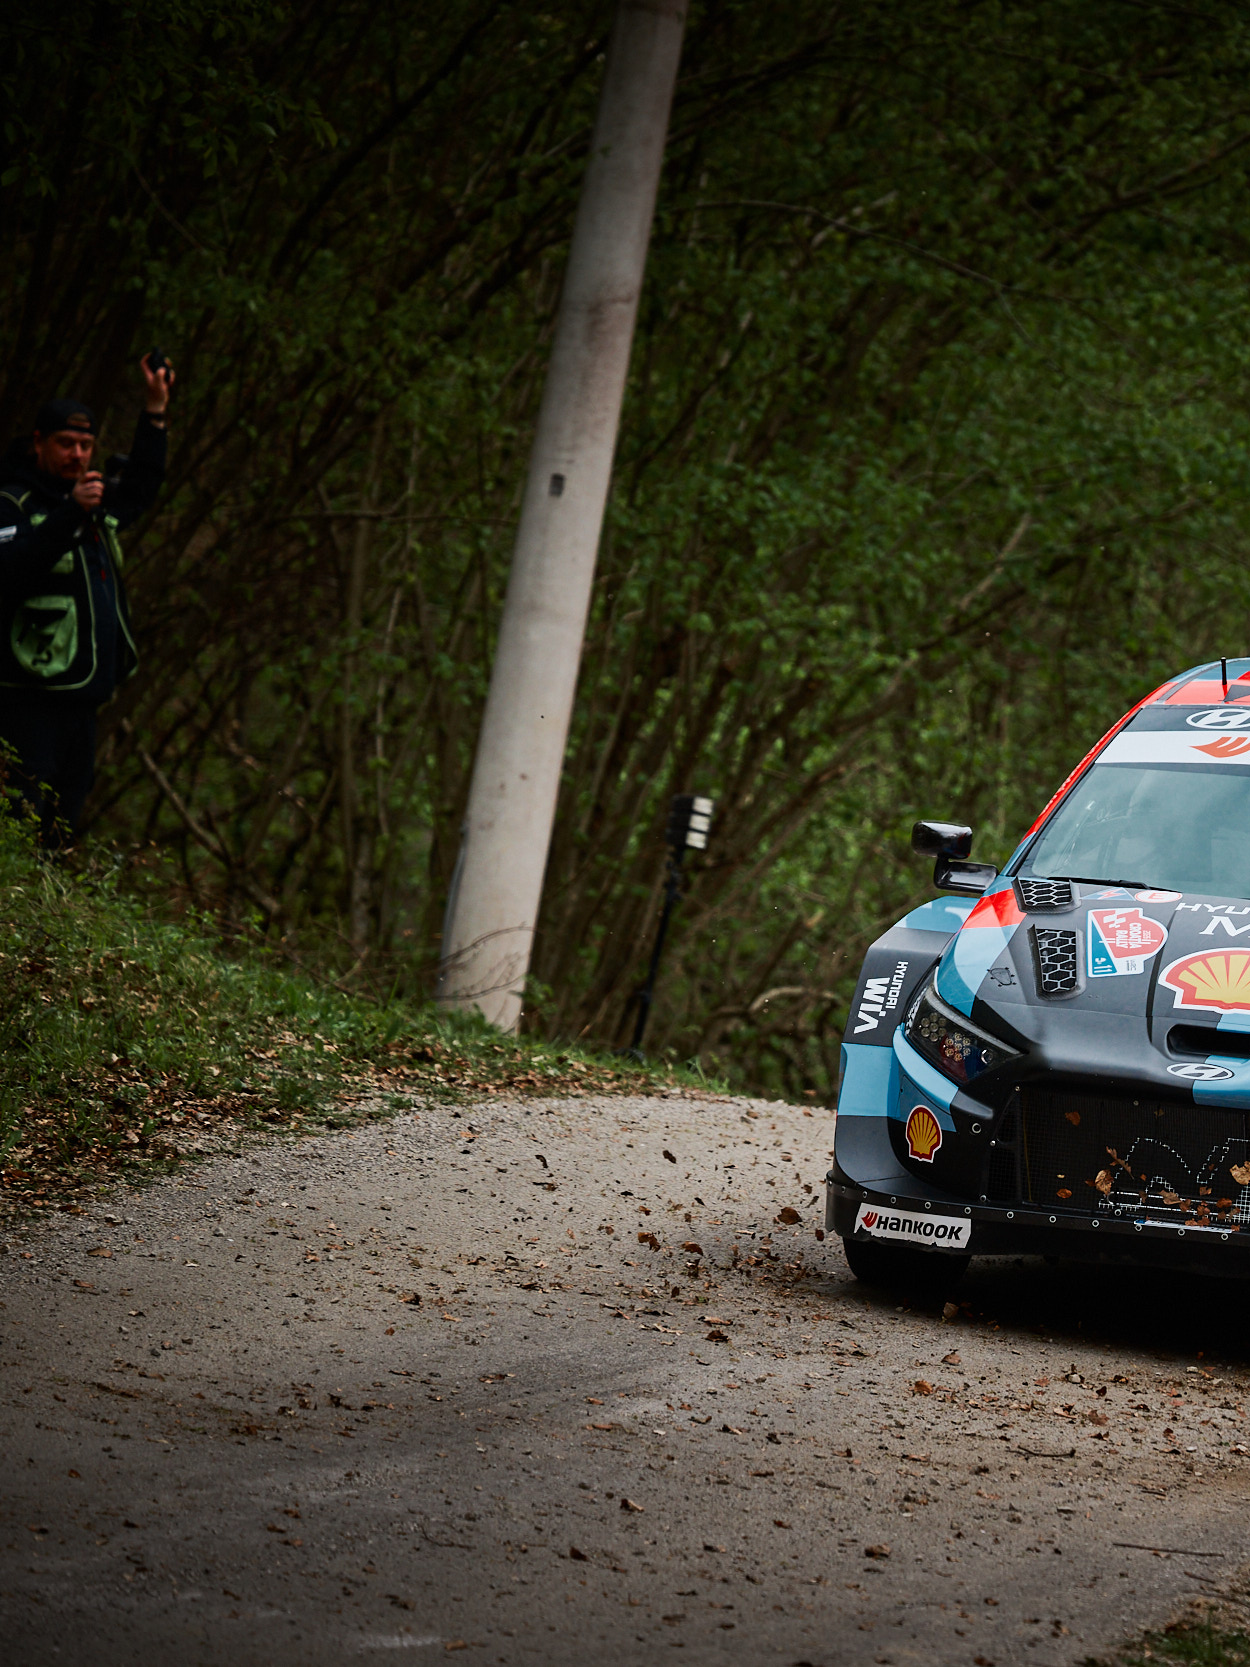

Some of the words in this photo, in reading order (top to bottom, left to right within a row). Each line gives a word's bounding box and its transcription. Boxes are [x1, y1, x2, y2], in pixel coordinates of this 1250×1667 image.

[1115, 929, 1129, 949] RALLY
[1129, 922, 1142, 949] CROATIA
[885, 960, 909, 1010] HYUNDAI
